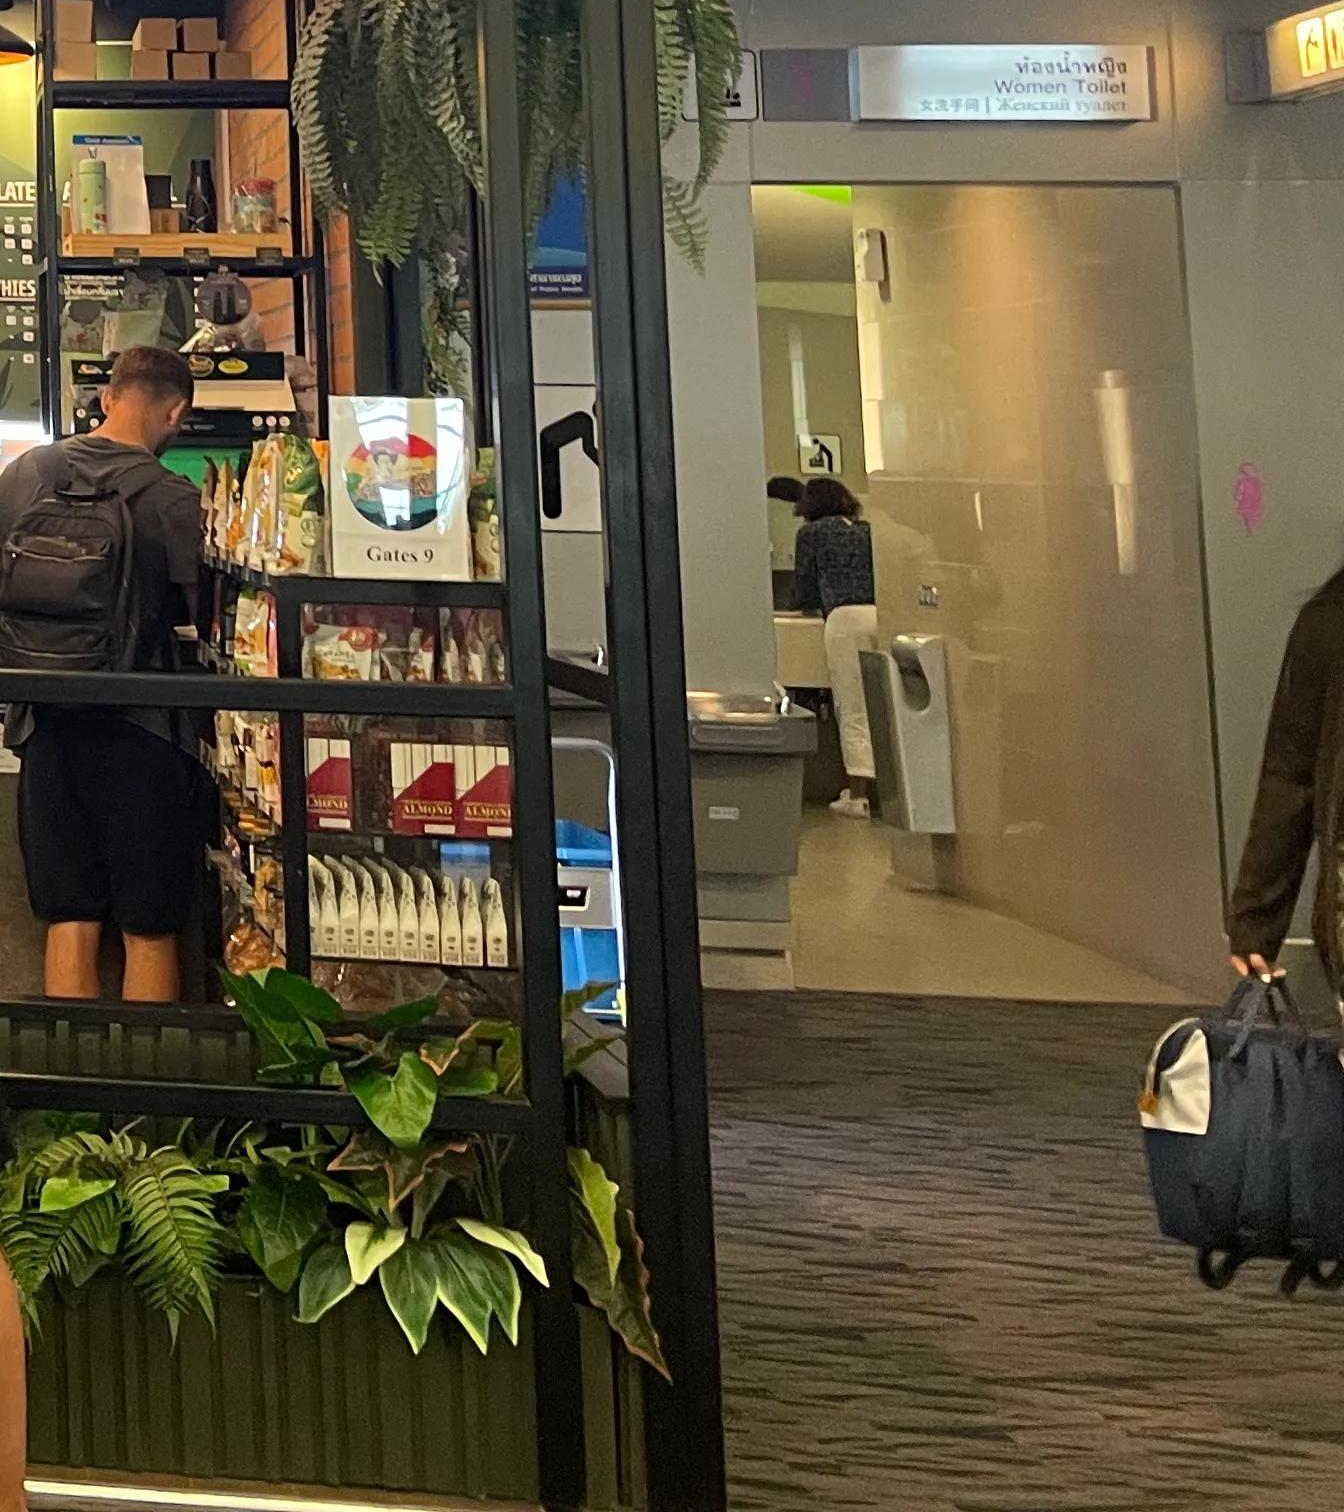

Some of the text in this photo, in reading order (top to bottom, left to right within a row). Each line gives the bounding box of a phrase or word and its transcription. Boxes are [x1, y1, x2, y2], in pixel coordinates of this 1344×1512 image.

[1016, 51, 1127, 78] ห้องน้ำหญิง
[995, 79, 1127, 95] Women Toilet
[367, 545, 434, 563] Gates 9
[307, 795, 348, 810] LMOND
[402, 802, 453, 816] ALMOND
